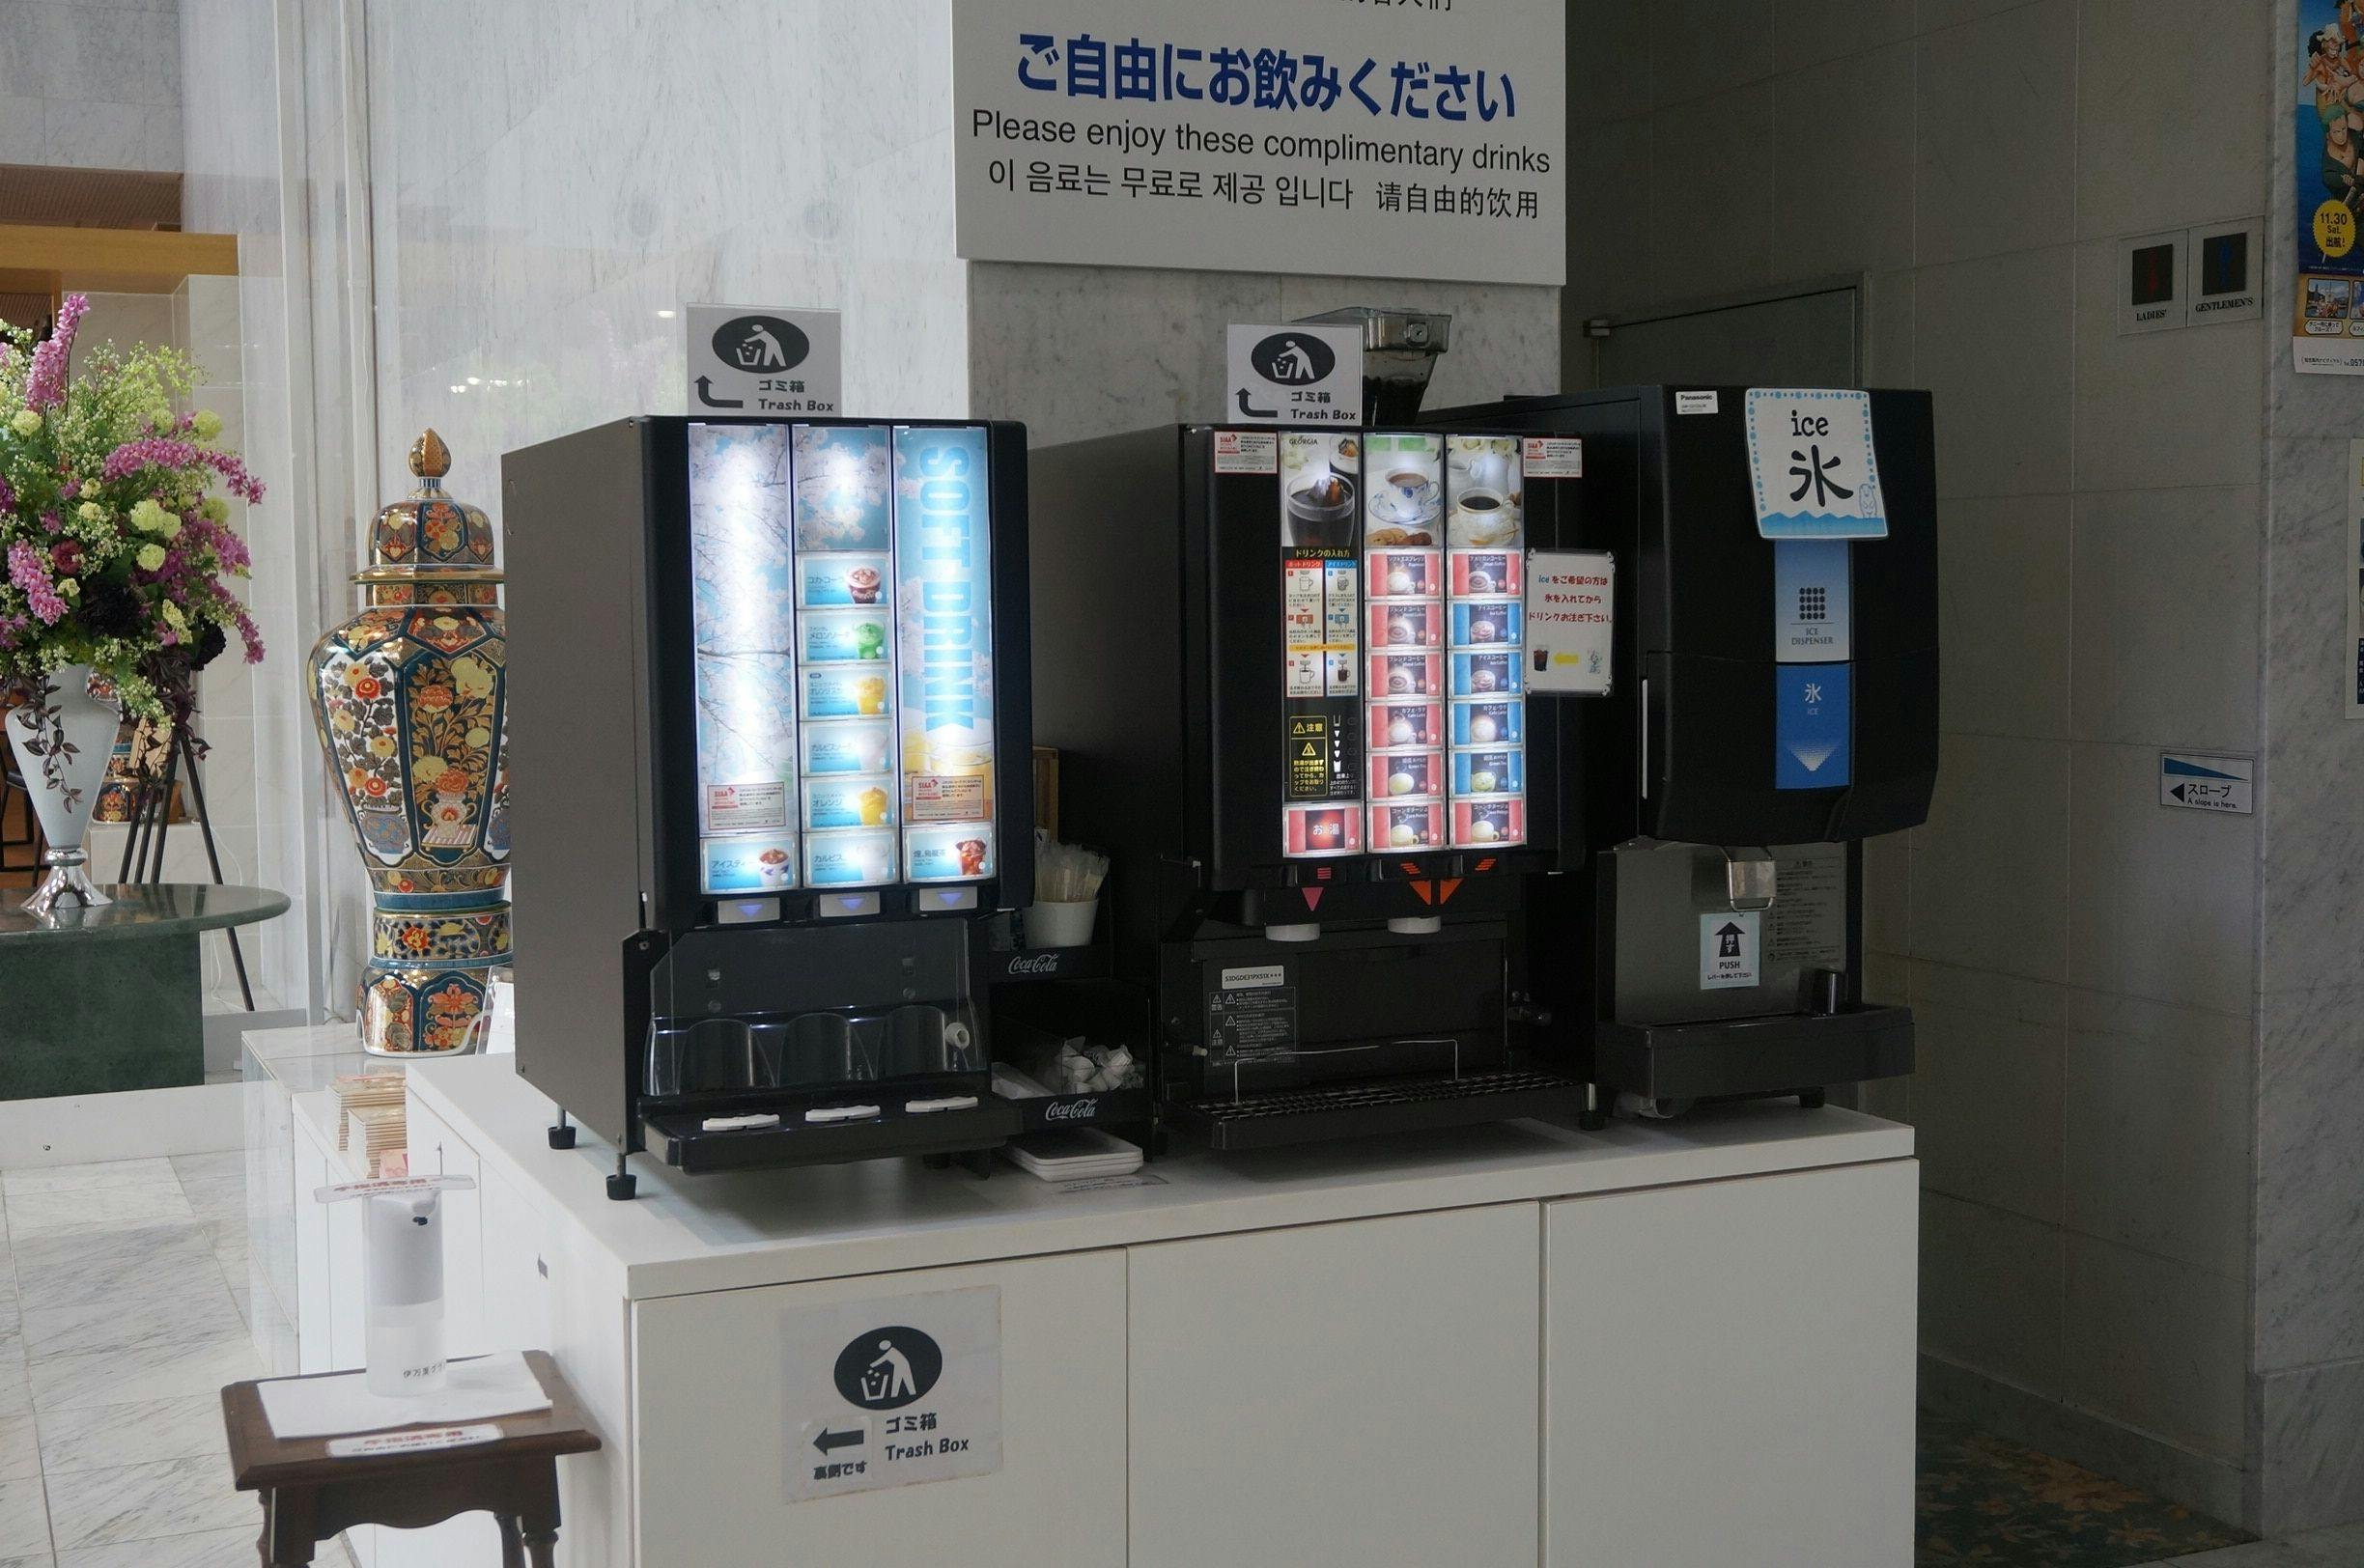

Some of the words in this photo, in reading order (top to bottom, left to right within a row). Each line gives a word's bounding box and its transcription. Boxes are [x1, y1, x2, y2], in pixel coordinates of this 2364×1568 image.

[1017, 33, 1516, 123] ご自由にお飲みください
[972, 108, 1076, 144] Please
[1085, 118, 1168, 155] enjoy
[1175, 124, 1255, 156] these
[1263, 132, 1465, 175] complimentary
[1472, 147, 1551, 175] drinks
[988, 159, 1015, 192] 이
[1027, 162, 1112, 197] 음료는
[1120, 167, 1204, 201] 무료로
[1212, 174, 1266, 206] 제공
[1276, 177, 1354, 211] 입니다
[1375, 181, 1540, 220] 请自由的饮用
[2321, 213, 2348, 225] 11.30
[2195, 296, 2254, 313] GENTLEMEN'S
[2136, 309, 2167, 322] LADIES'
[758, 379, 805, 393] ゴミ箱
[758, 398, 802, 411] Trash
[807, 400, 834, 411] Box
[1290, 391, 1331, 404] ゴミ箱
[1290, 407, 1329, 420] Trash
[1333, 409, 1357, 420] Box
[1790, 409, 1829, 436] ice
[1789, 444, 1854, 508] 氷
[919, 446, 971, 568] SOFT
[1296, 548, 1350, 558] ドリンクの入れ方
[1538, 574, 1550, 584] ice
[1551, 575, 1608, 586] をご希望の方は
[1544, 593, 1602, 604] 氷を入れてから
[1529, 612, 1614, 624] ドリンクお注ぎ下さい。
[1806, 628, 1818, 636] ICE
[1791, 636, 1834, 646] DISPENSER
[1804, 683, 1822, 704] 氷
[1306, 722, 1323, 732] 注意
[2187, 783, 2233, 798] スロープ
[2195, 798, 2211, 807] slope
[1312, 823, 1340, 835] お湯
[1008, 953, 1060, 975] Coca-Cola
[1719, 961, 1740, 969] PUSH
[1045, 1098, 1098, 1121] Coca-Cola
[886, 1412, 938, 1435] ゴミ箱
[885, 1438, 934, 1462] Trash
[939, 1438, 970, 1454] Box
[813, 1460, 867, 1480] 裏側です
